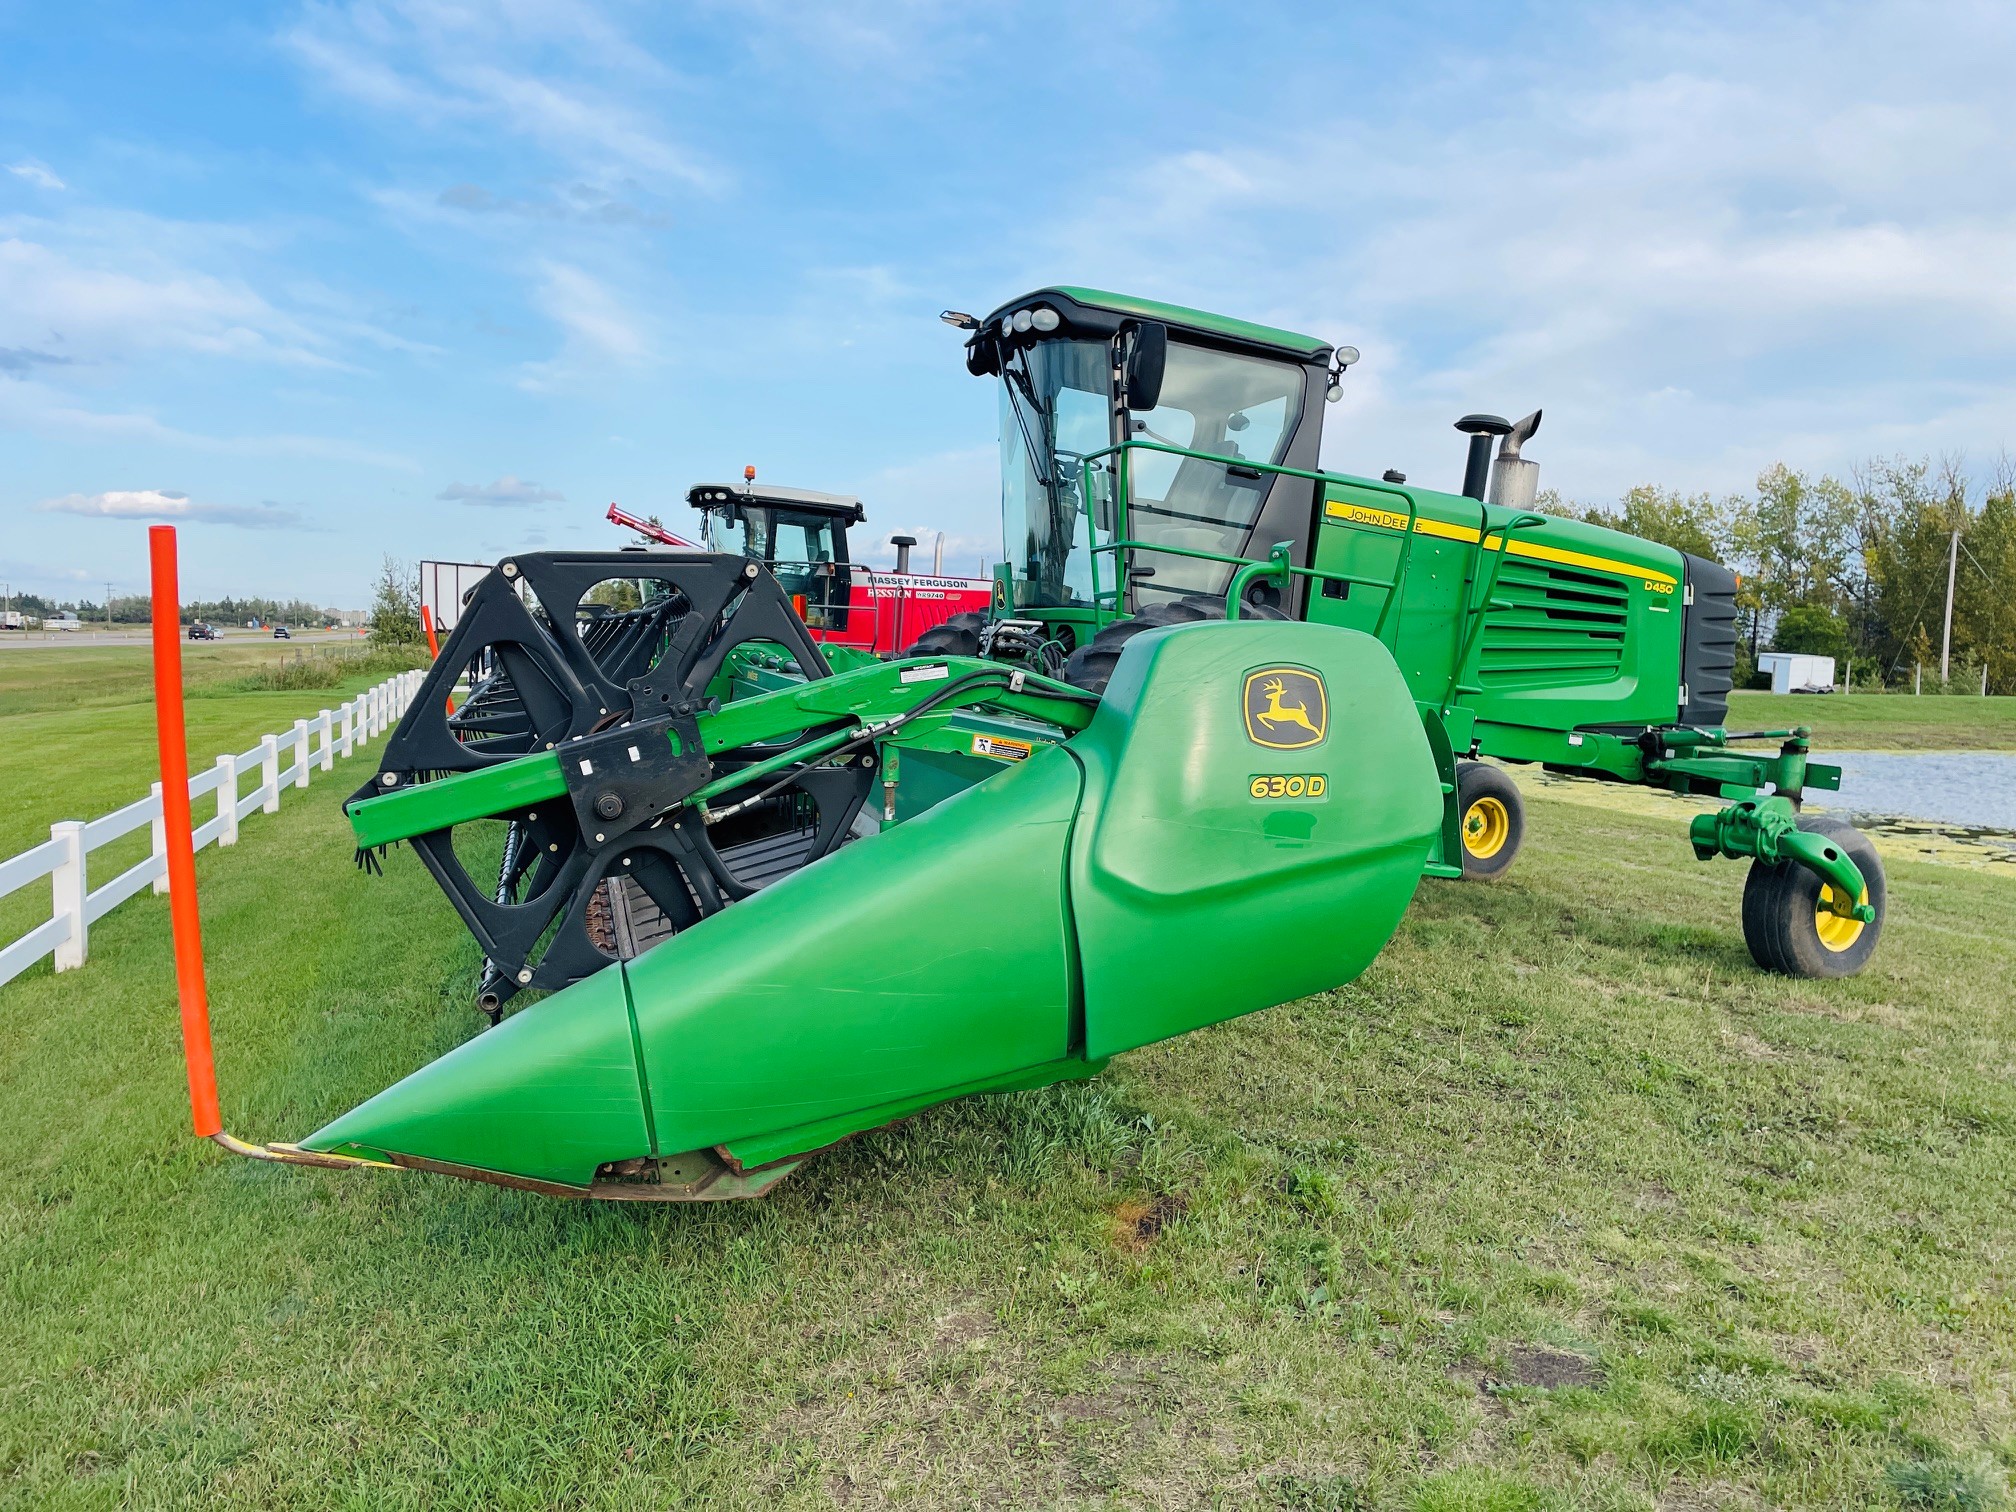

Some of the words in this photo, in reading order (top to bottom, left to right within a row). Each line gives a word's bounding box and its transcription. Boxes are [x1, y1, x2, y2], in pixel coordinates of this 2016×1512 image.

[1347, 508, 1380, 524] JOHN
[1382, 514, 1423, 531] DEEE
[868, 577, 910, 586] MASSEY
[914, 579, 968, 588] FERGUSON
[1644, 580, 1674, 594] D450
[1250, 775, 1326, 798] 630D
